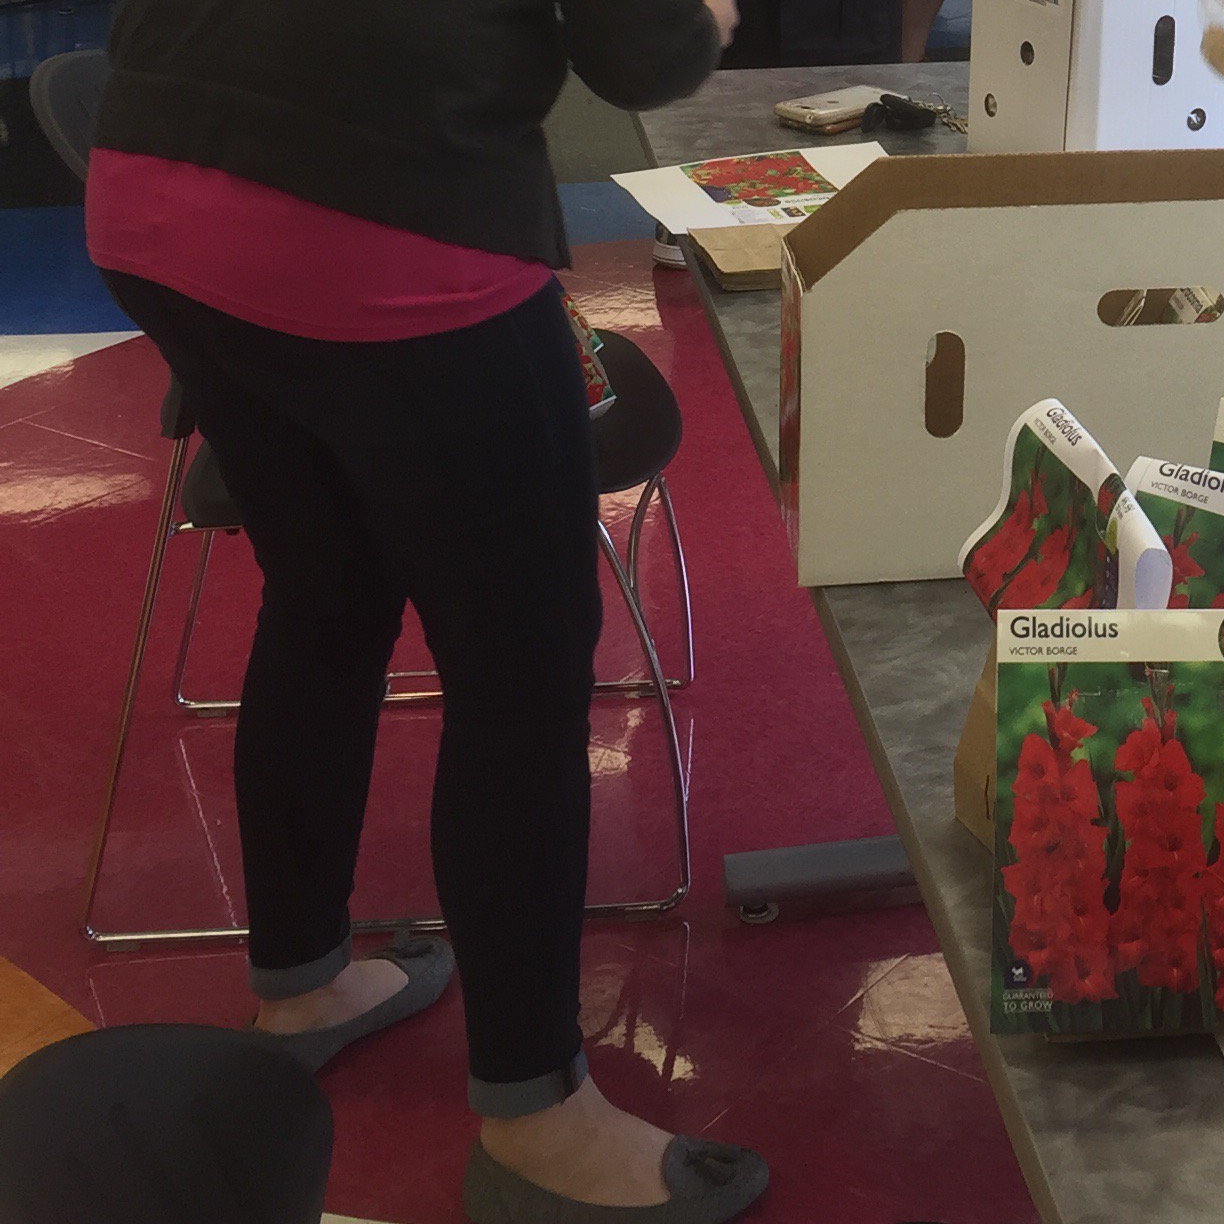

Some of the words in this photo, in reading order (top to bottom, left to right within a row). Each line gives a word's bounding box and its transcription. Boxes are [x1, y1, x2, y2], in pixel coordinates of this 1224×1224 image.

[1046, 407, 1083, 446] Gladiolus
[1150, 480, 1179, 495] VICTOR
[1180, 489, 1210, 505] BORGE
[1010, 615, 1119, 639] Gladiolus
[1008, 646, 1044, 656] VICTOR
[1046, 646, 1078, 656] BORGE
[1003, 1001, 1017, 1014] TO
[1020, 1000, 1054, 1011] GROW
